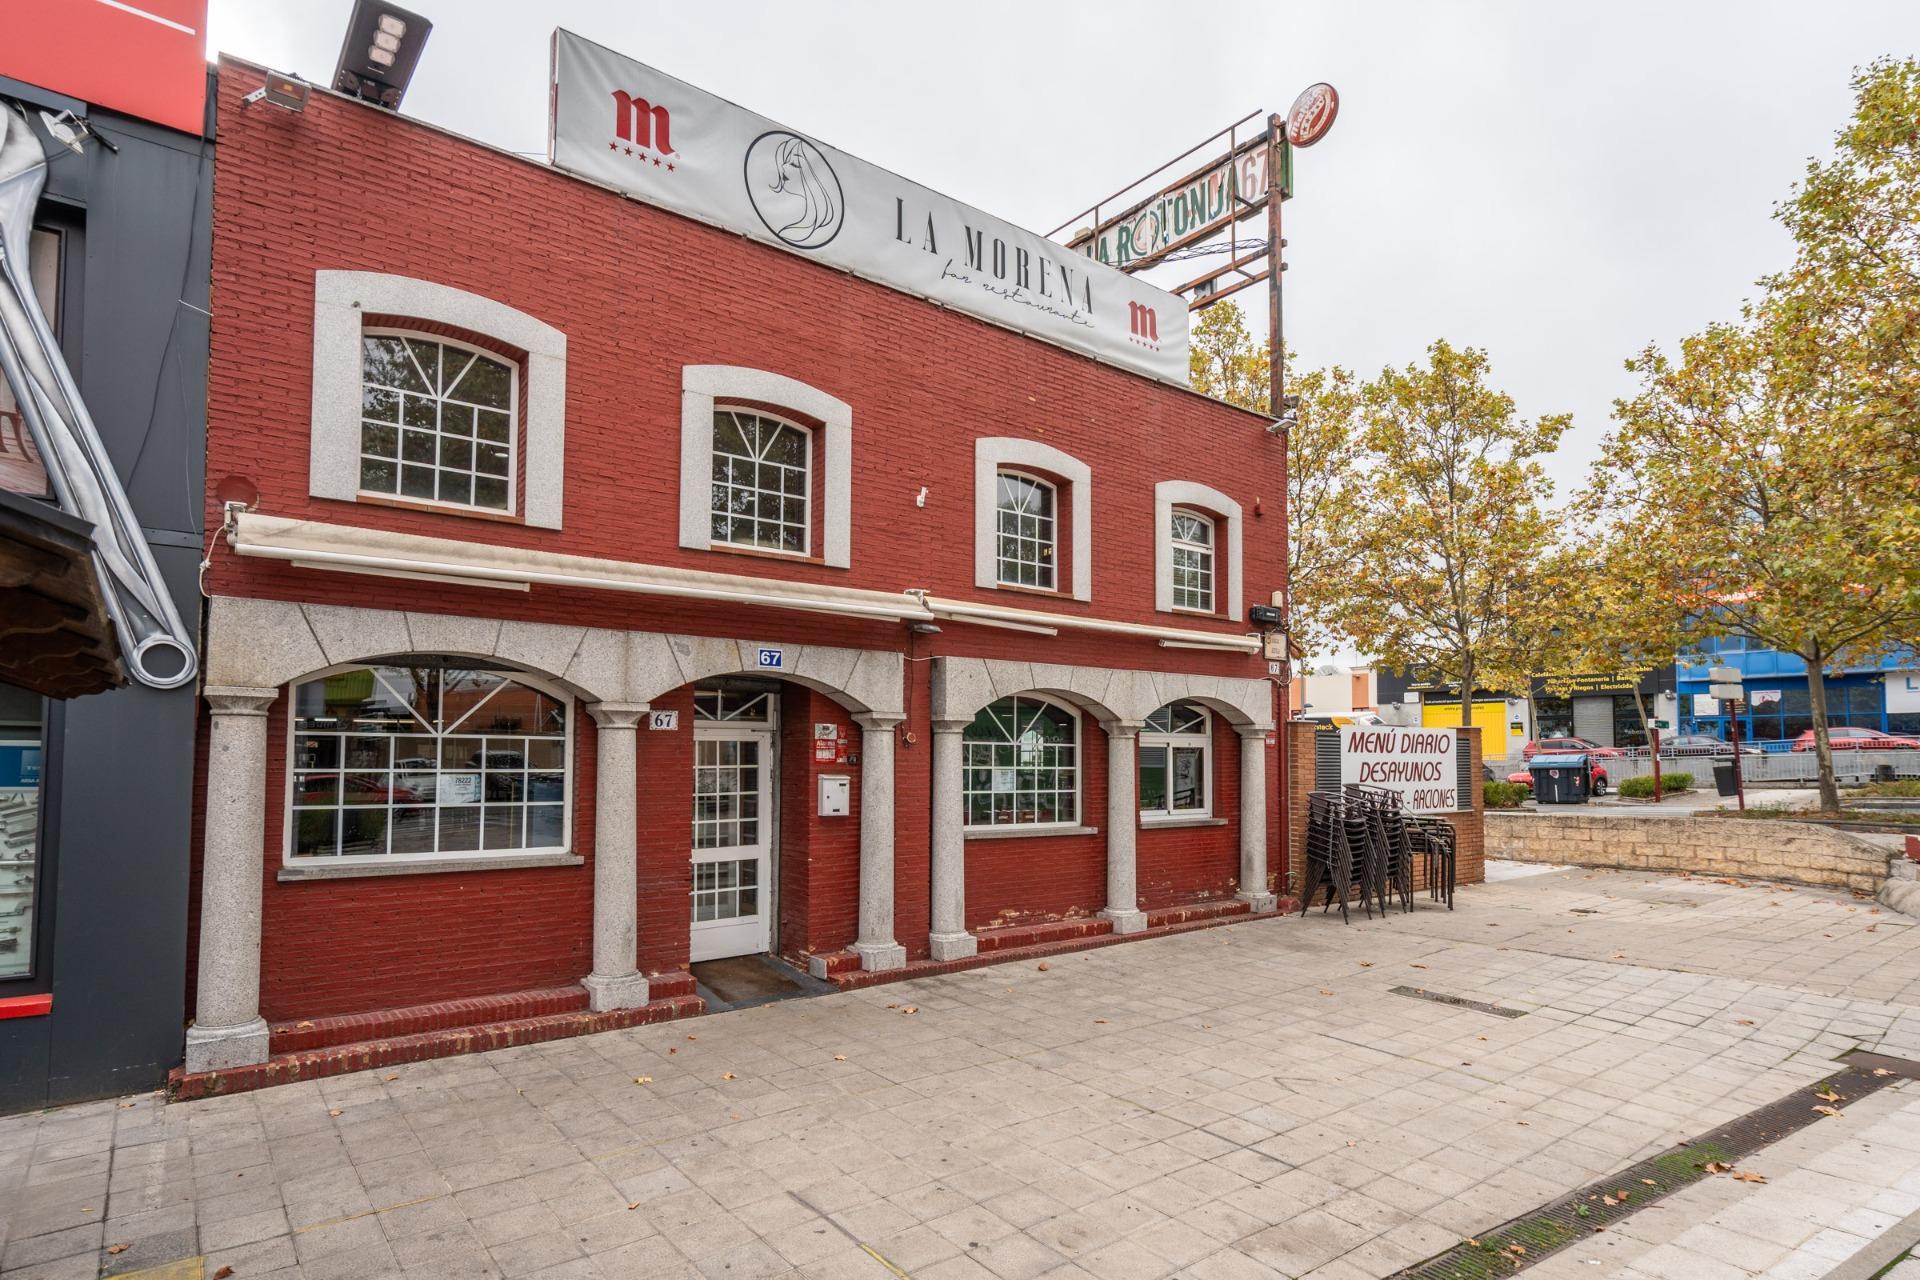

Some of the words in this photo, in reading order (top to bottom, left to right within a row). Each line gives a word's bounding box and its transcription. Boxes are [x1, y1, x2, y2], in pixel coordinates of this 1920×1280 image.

[1241, 147, 1268, 201] 67
[895, 196, 938, 255] LA
[963, 224, 1093, 315] MORENA
[982, 281, 1095, 329] restaurante
[760, 651, 781, 665] 67
[1270, 663, 1279, 673] 67
[654, 713, 673, 728] 67
[1347, 727, 1397, 753] MENÚ
[1400, 733, 1451, 755] DIARIO
[1359, 761, 1443, 783] DESAYUNOS
[1412, 788, 1456, 810] RACIONES
